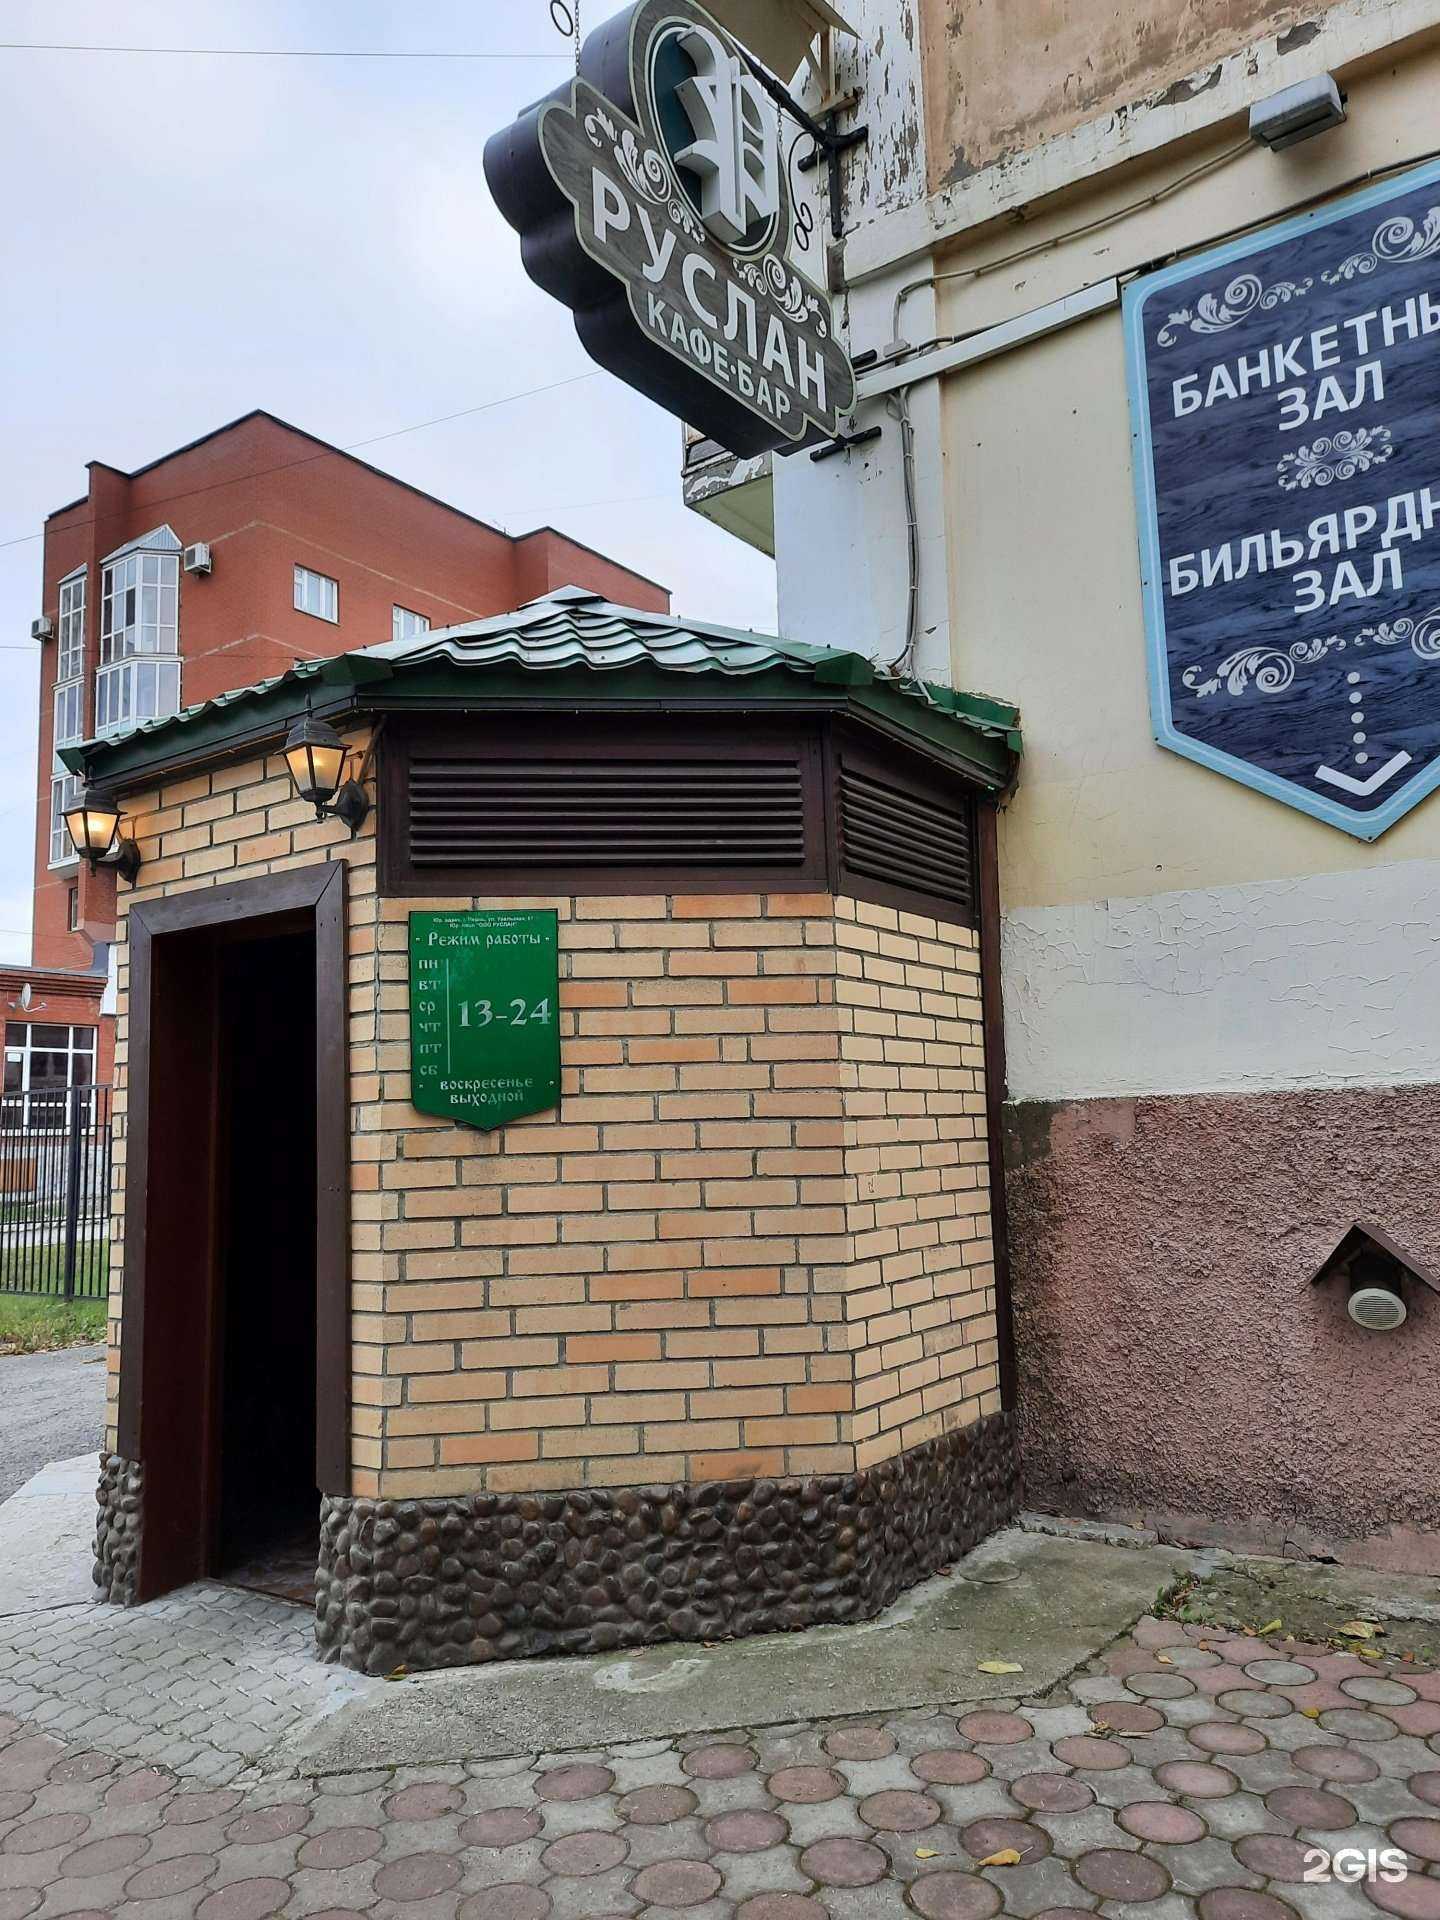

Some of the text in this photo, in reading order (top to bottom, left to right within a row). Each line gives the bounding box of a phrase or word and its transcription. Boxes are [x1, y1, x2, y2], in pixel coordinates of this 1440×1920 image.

[592, 167, 826, 412] РУСЛАН
[1277, 360, 1385, 431] ЗАЛ
[1293, 548, 1403, 614] ЗАЛ
[428, 931, 541, 949] Режим работы
[457, 996, 552, 1028] 13-24
